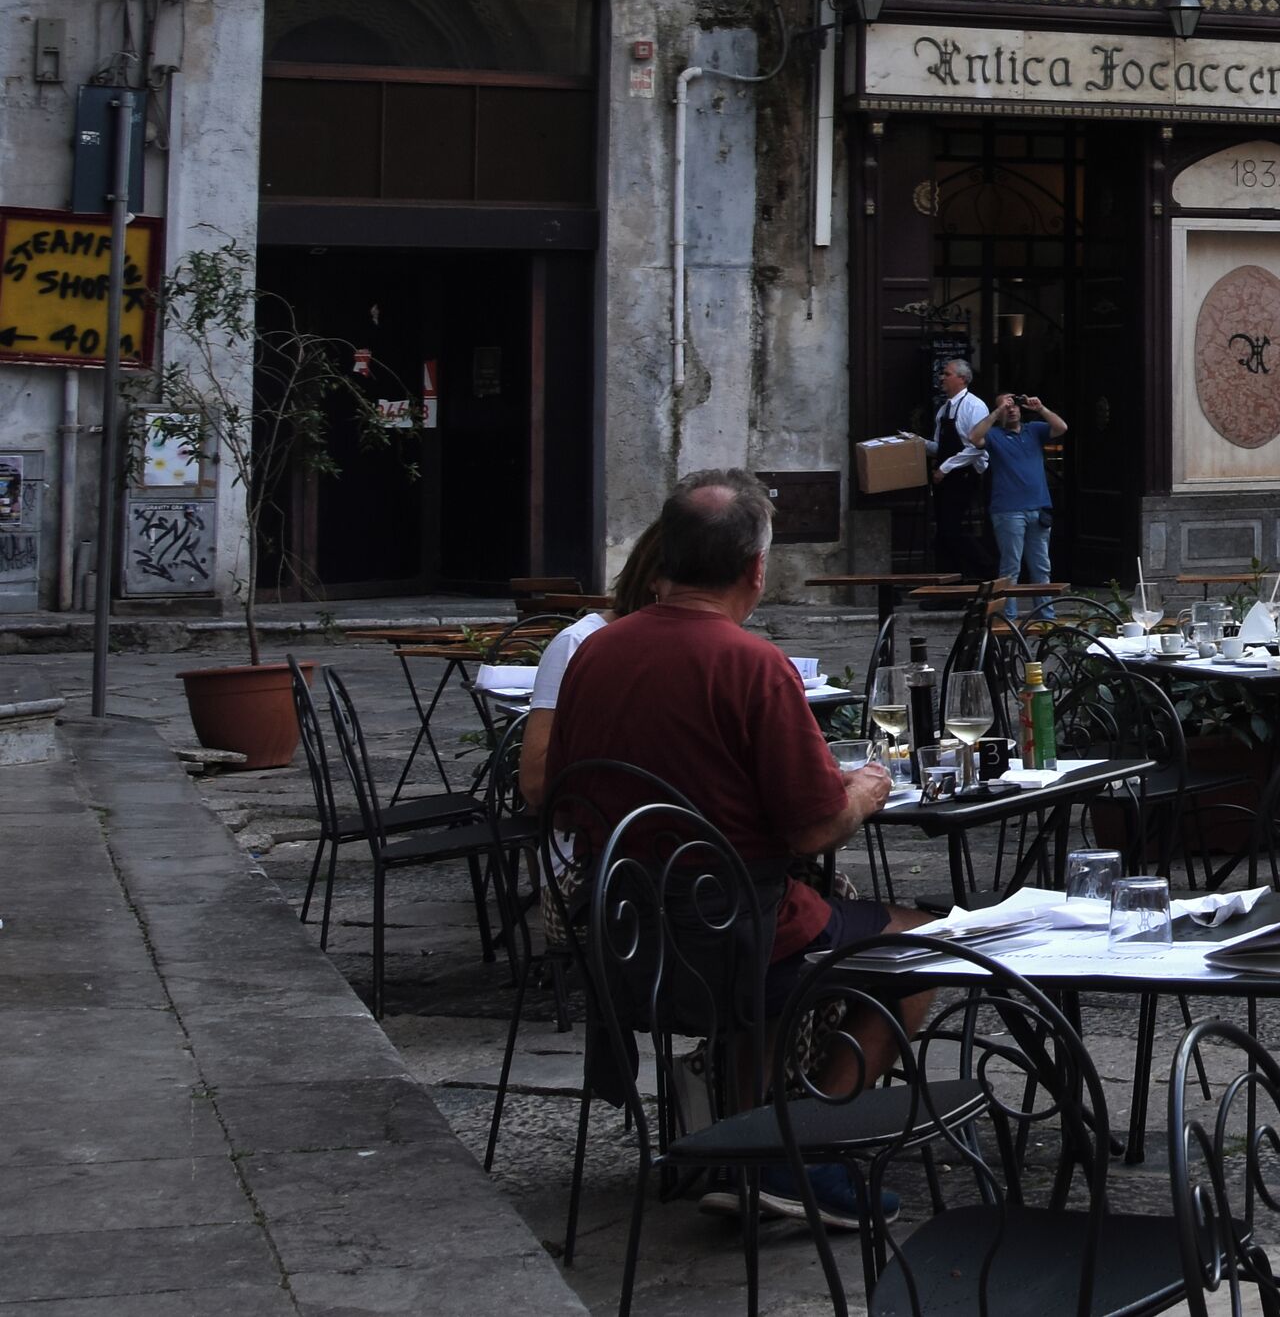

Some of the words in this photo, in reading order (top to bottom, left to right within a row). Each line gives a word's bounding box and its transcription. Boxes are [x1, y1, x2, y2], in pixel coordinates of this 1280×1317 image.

[913, 36, 1073, 86] Antica
[49, 324, 99, 355] 40
[985, 742, 1000, 765] 3
